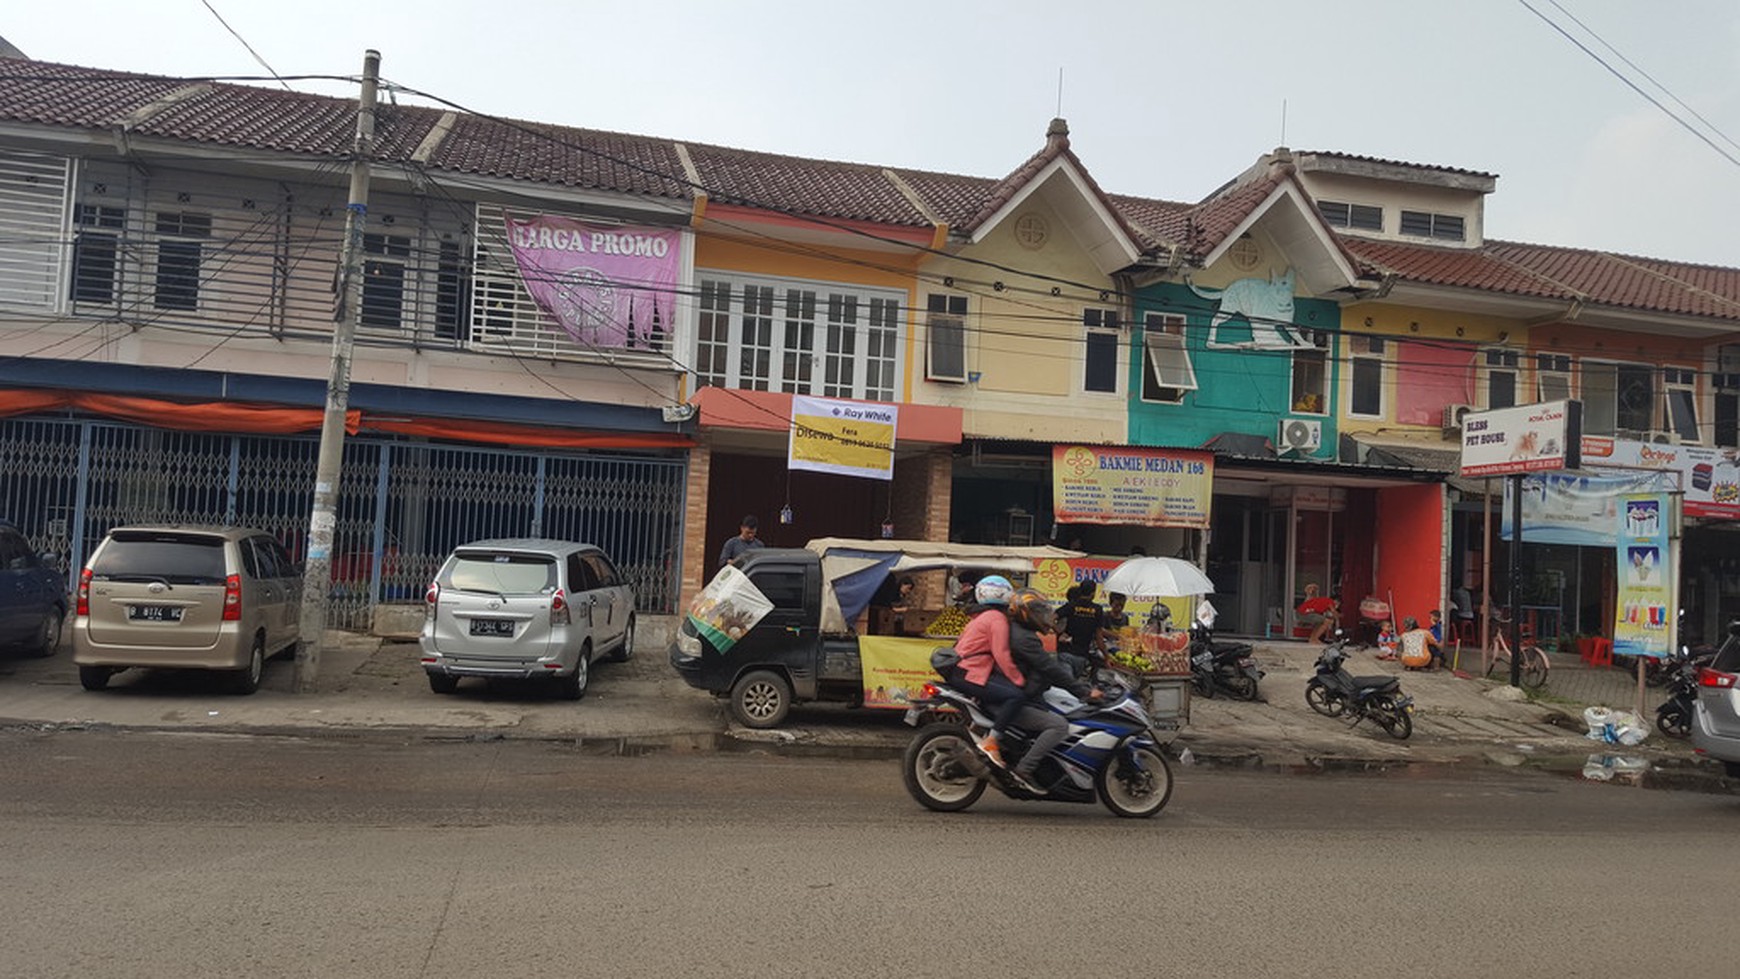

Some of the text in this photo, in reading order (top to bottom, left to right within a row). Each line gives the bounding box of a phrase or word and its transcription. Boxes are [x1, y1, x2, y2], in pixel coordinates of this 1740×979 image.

[590, 232, 669, 258] PROMO
[844, 407, 892, 422] Ray White
[1467, 419, 1488, 432] BLESS
[1466, 431, 1505, 446] PET HOUSE
[1099, 455, 1205, 475] BAKMIE MEDAN 168
[1075, 568, 1109, 583] BAKM
